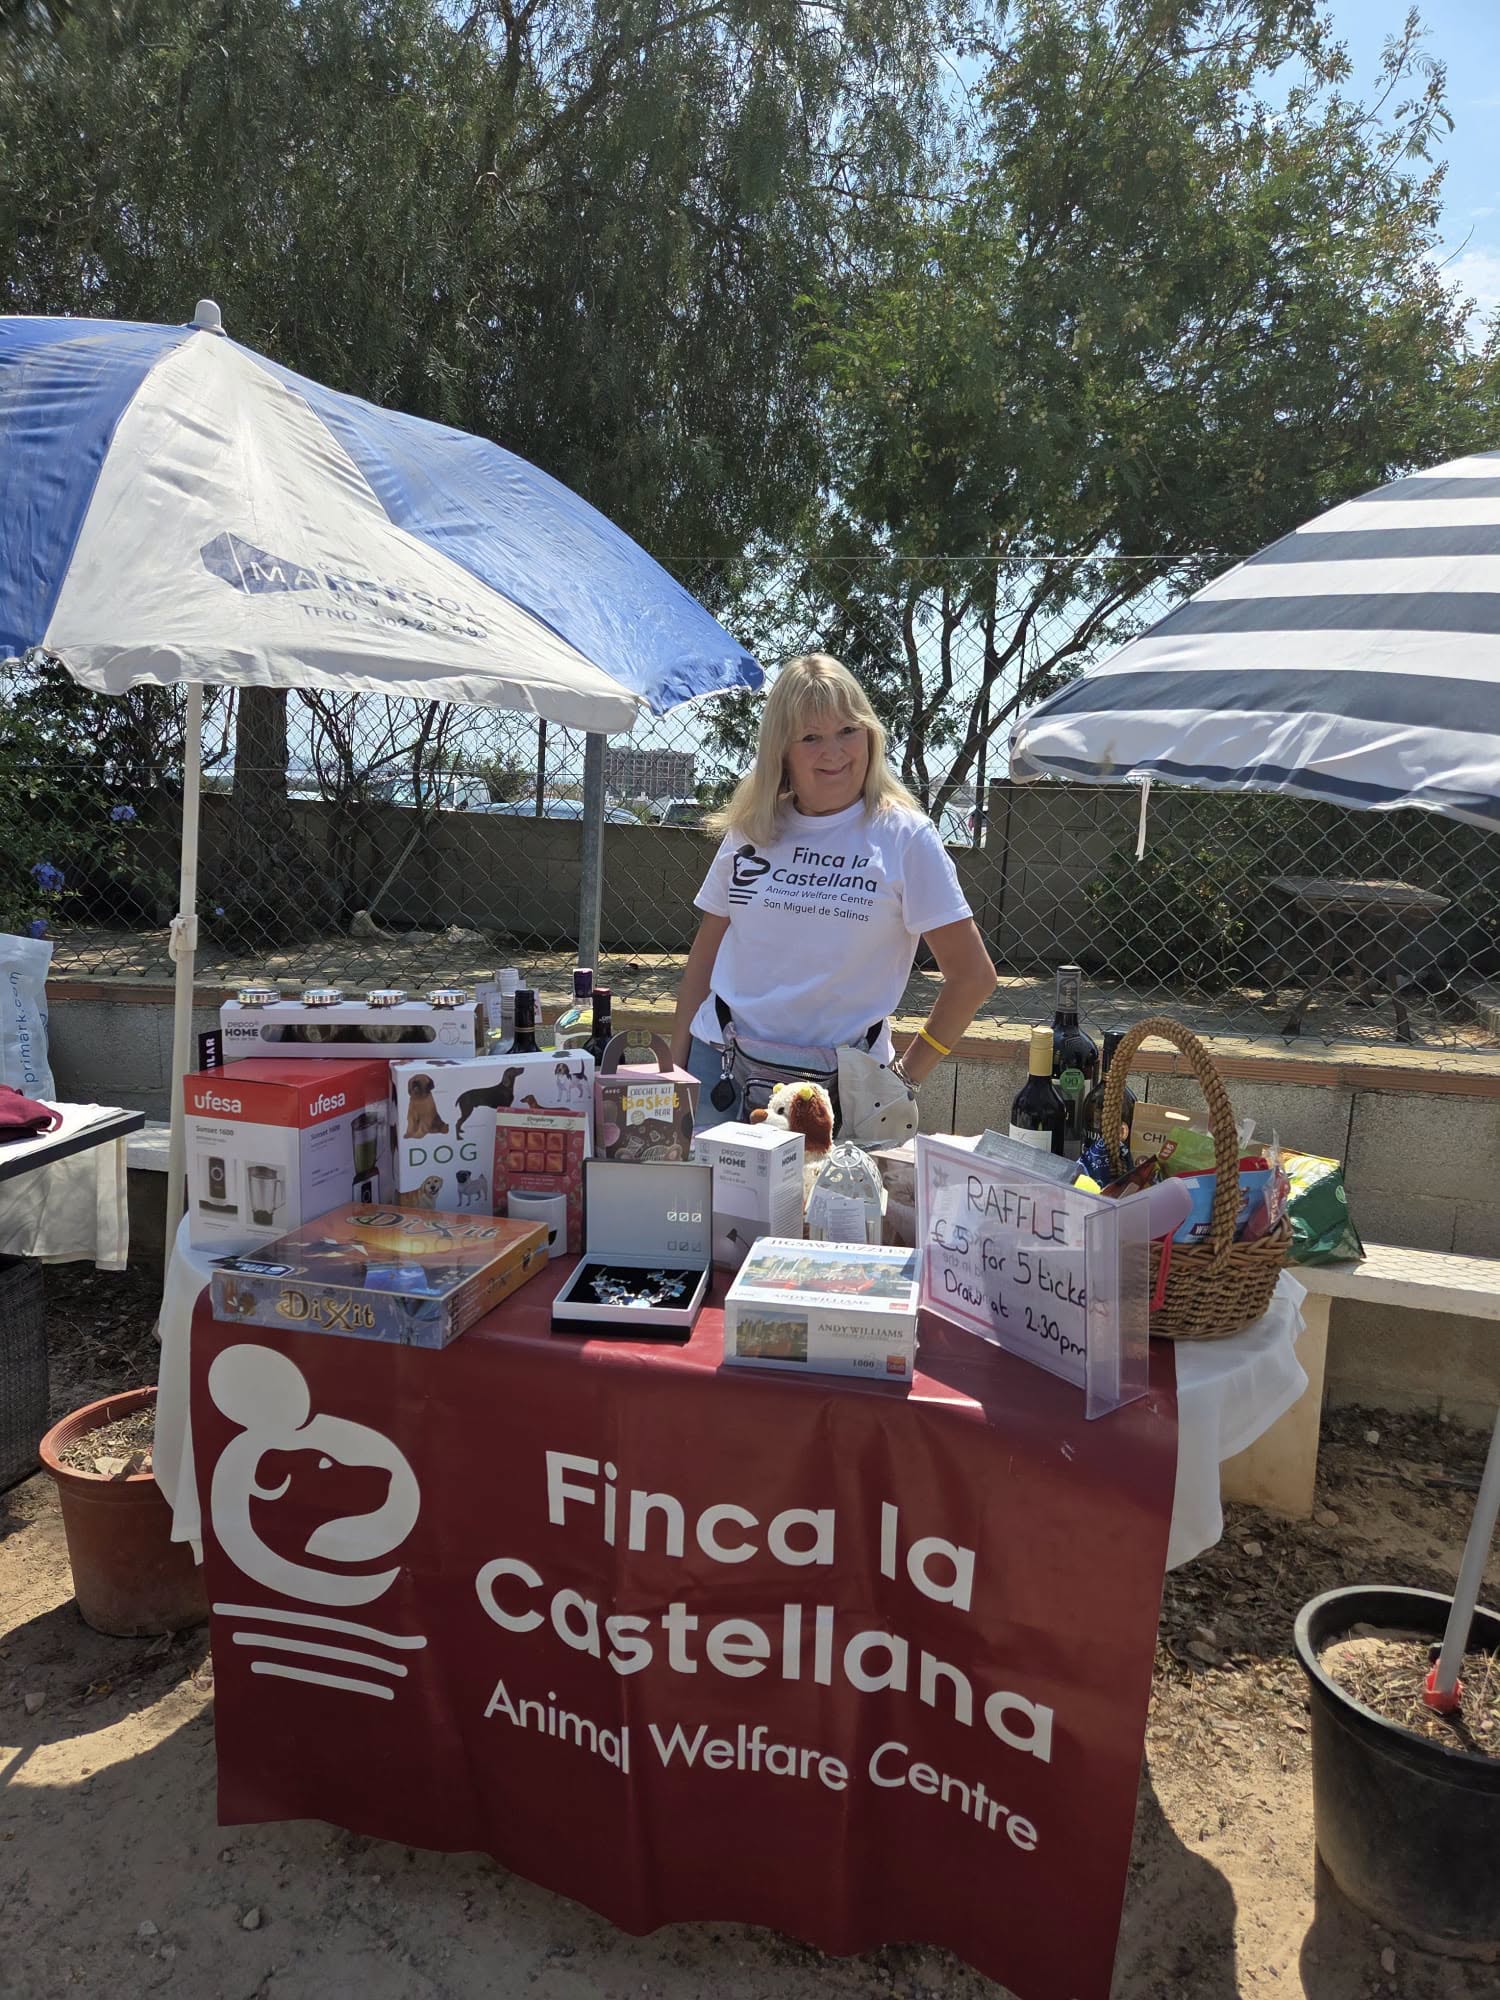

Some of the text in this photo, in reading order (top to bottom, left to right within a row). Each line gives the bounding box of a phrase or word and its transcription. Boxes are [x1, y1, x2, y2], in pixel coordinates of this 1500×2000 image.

[300, 603, 357, 622] TFNO
[792, 846, 870, 870] Finca la
[772, 868, 878, 893] Castellana
[765, 885, 874, 907] Animal Welfare Centre
[763, 898, 870, 922] San Miguel de Salinas
[225, 1028, 259, 1038] HOME
[194, 1091, 242, 1114] ufesa
[309, 1092, 346, 1117] ufesa
[622, 1091, 680, 1112] Basket
[654, 1108, 671, 1117] BEAR
[195, 1125, 218, 1135] Sunset
[409, 1142, 478, 1167] DOG
[718, 1155, 746, 1169] HOME
[781, 1152, 797, 1168] HOME
[967, 1175, 1070, 1247] RAFFLE
[771, 1239, 907, 1255] JIGSAW PUZZLES
[981, 1237, 1006, 1272] for
[1012, 1251, 1032, 1285] 5
[943, 1268, 984, 1306] Draw
[990, 1291, 1009, 1319] at
[817, 1323, 848, 1334] ANDY
[848, 1326, 903, 1339] WILLIAMS
[852, 1358, 875, 1369] 1000
[544, 1450, 977, 1613] Finca la
[474, 1556, 1055, 1764] Castellana
[483, 1679, 1038, 1852] Animal Welfare Centre
